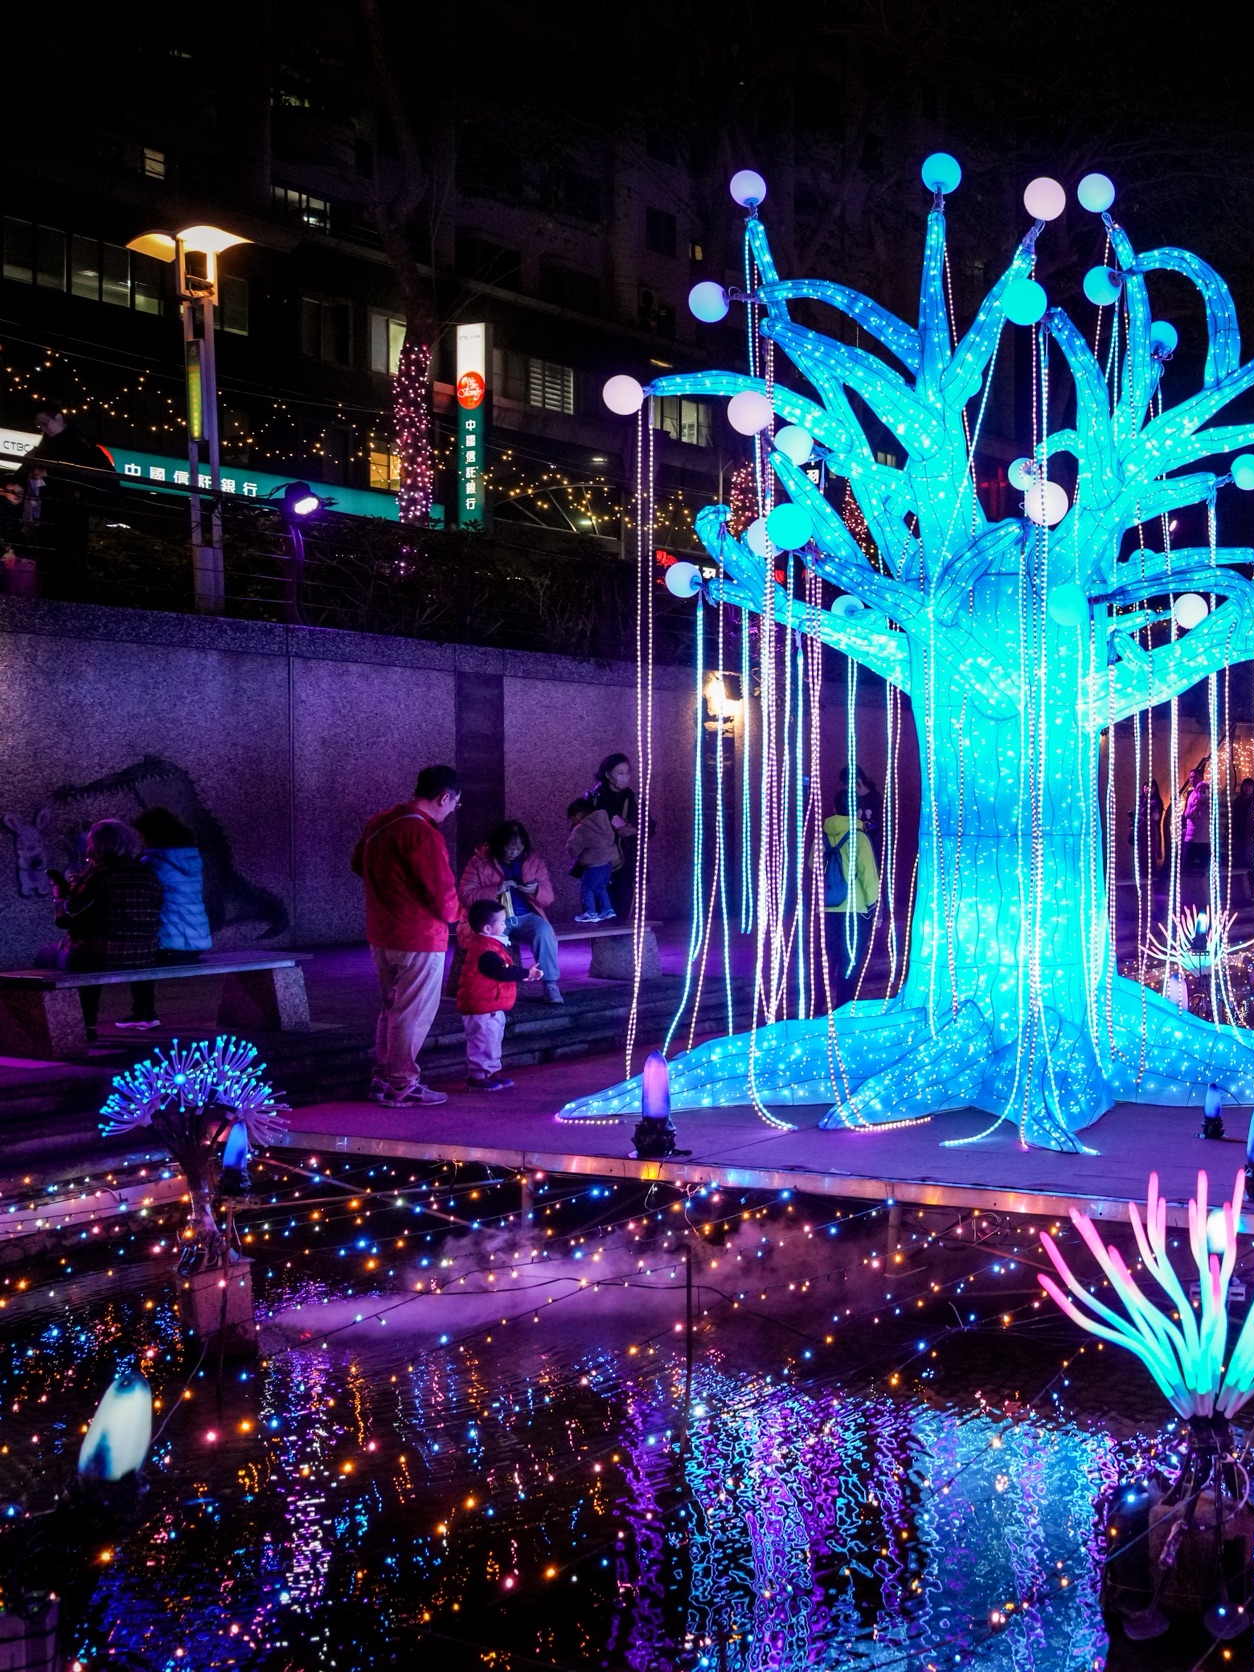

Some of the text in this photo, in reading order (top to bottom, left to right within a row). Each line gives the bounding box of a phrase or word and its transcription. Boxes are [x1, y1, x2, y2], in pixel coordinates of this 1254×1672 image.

[3, 440, 31, 453] CTBC
[124, 463, 258, 498] 中國信託銀行
[465, 419, 476, 510] 中國信託銀行
